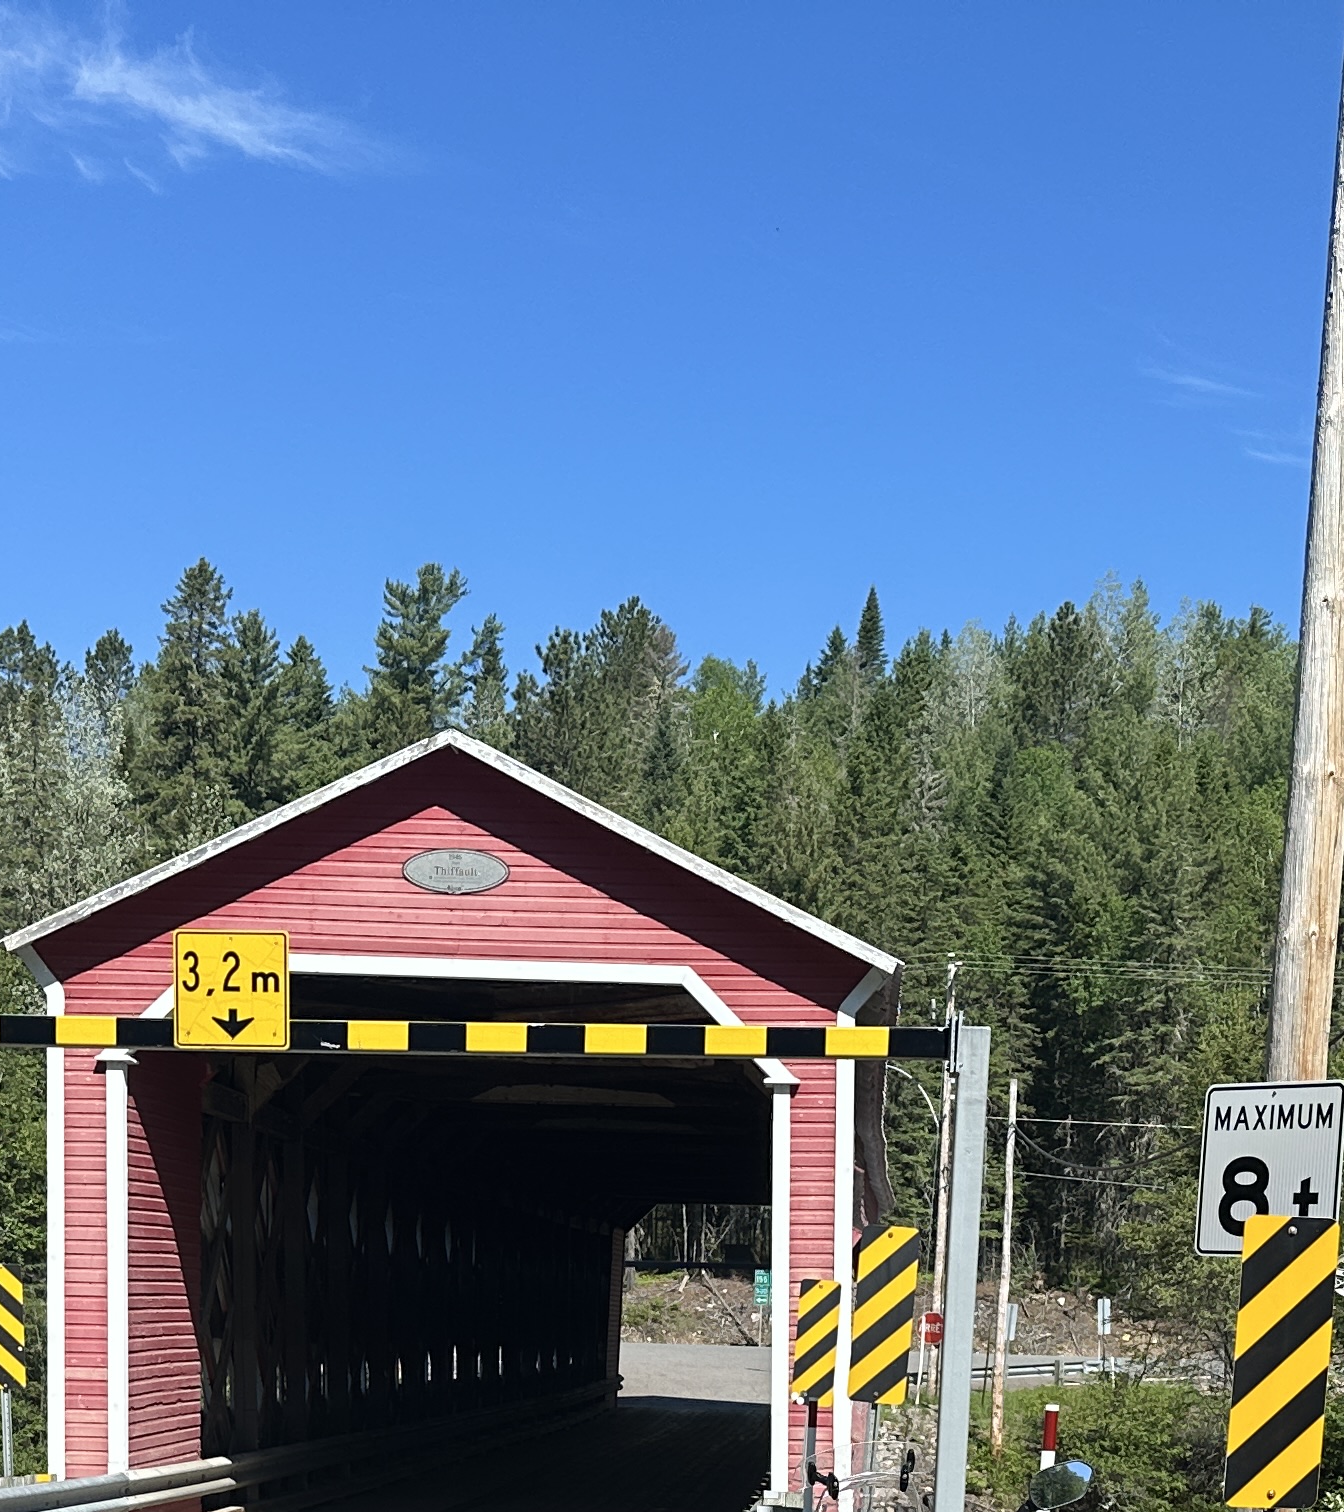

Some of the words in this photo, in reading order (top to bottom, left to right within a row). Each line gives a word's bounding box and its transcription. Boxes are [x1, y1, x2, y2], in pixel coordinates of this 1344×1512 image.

[434, 865, 478, 877] Thiffault
[182, 950, 241, 997] 3,2
[251, 971, 280, 993] m
[1214, 1102, 1334, 1131] MAXIMUM
[1218, 1156, 1270, 1237] 8
[1292, 1176, 1319, 1217] t
